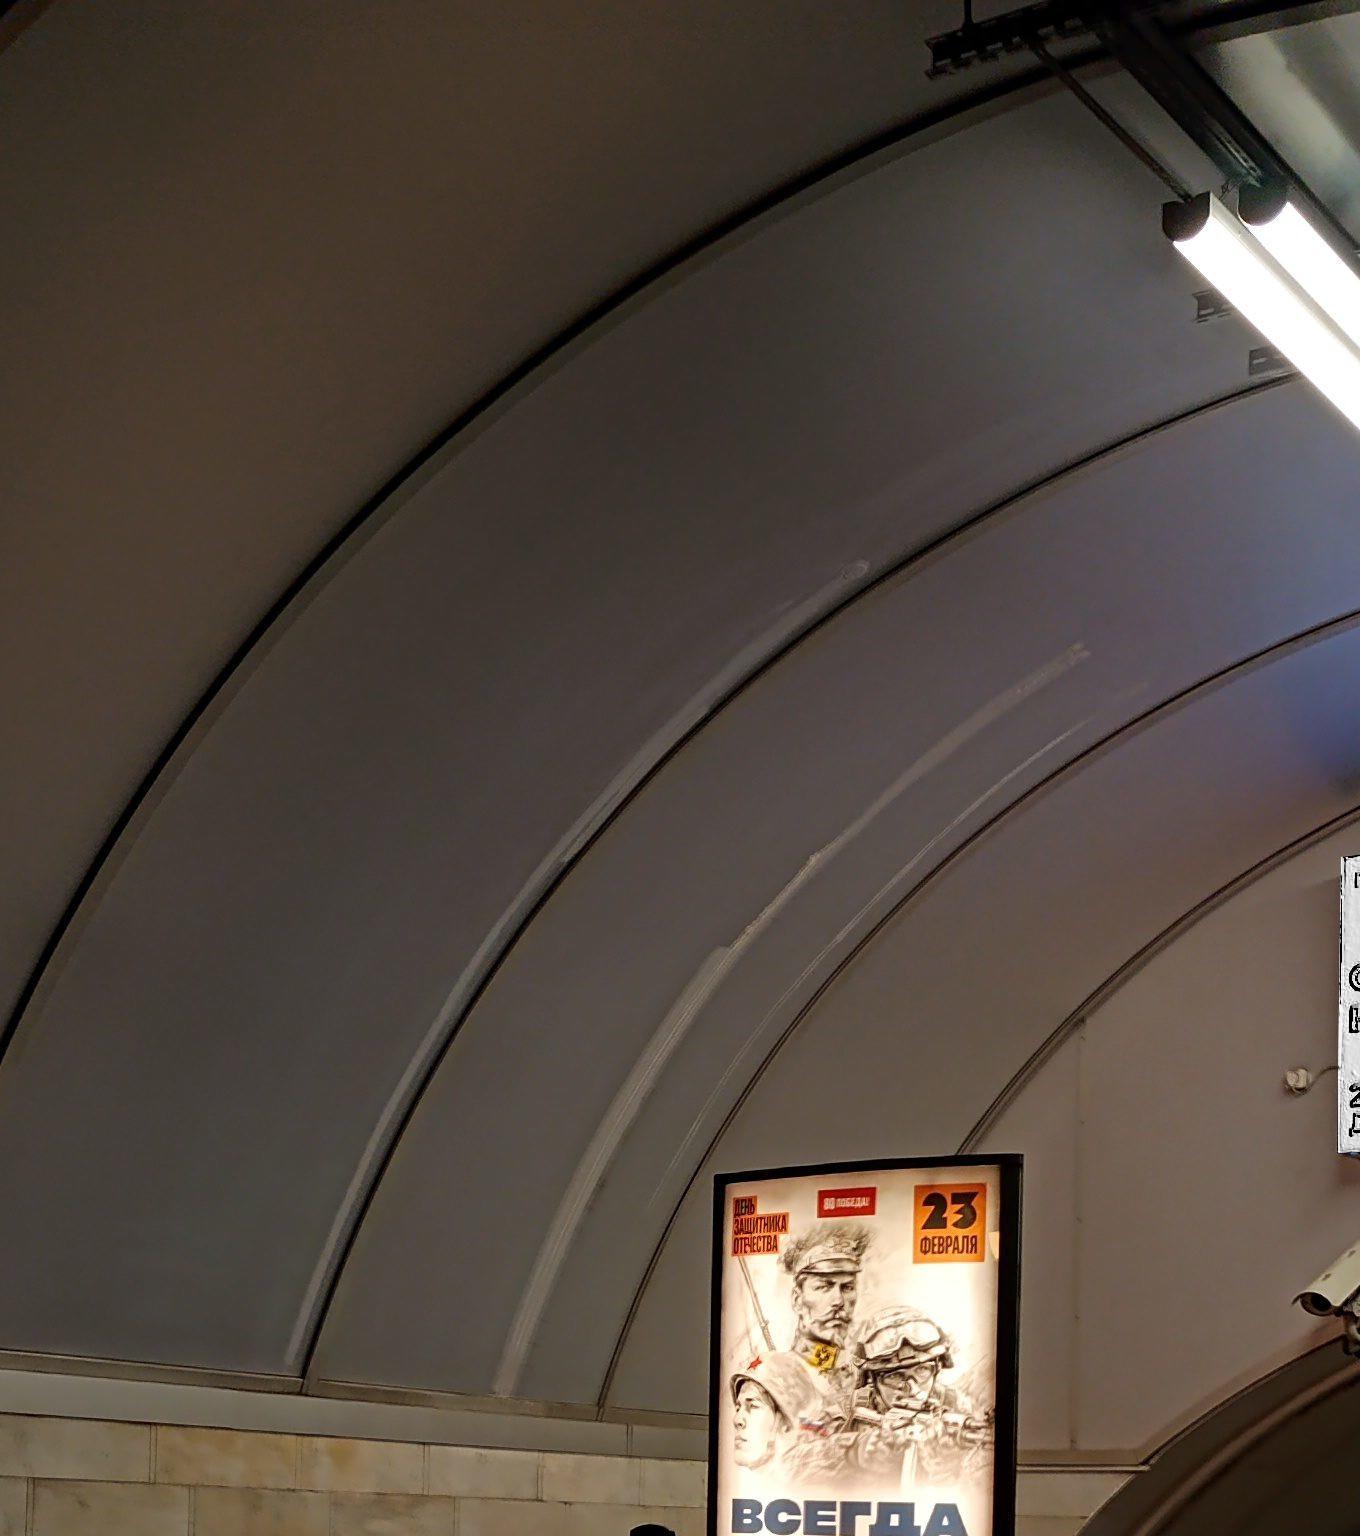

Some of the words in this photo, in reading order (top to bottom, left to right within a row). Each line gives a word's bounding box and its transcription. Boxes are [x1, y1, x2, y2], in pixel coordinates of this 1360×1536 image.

[733, 1198, 757, 1218] ДЕНЬ
[920, 1191, 980, 1230] 23
[733, 1213, 788, 1236] ЗАЩИТНИКА
[733, 1234, 780, 1255] ОТЕЧЕСТВА
[919, 1235, 979, 1256] ФЕВРАЛЯ
